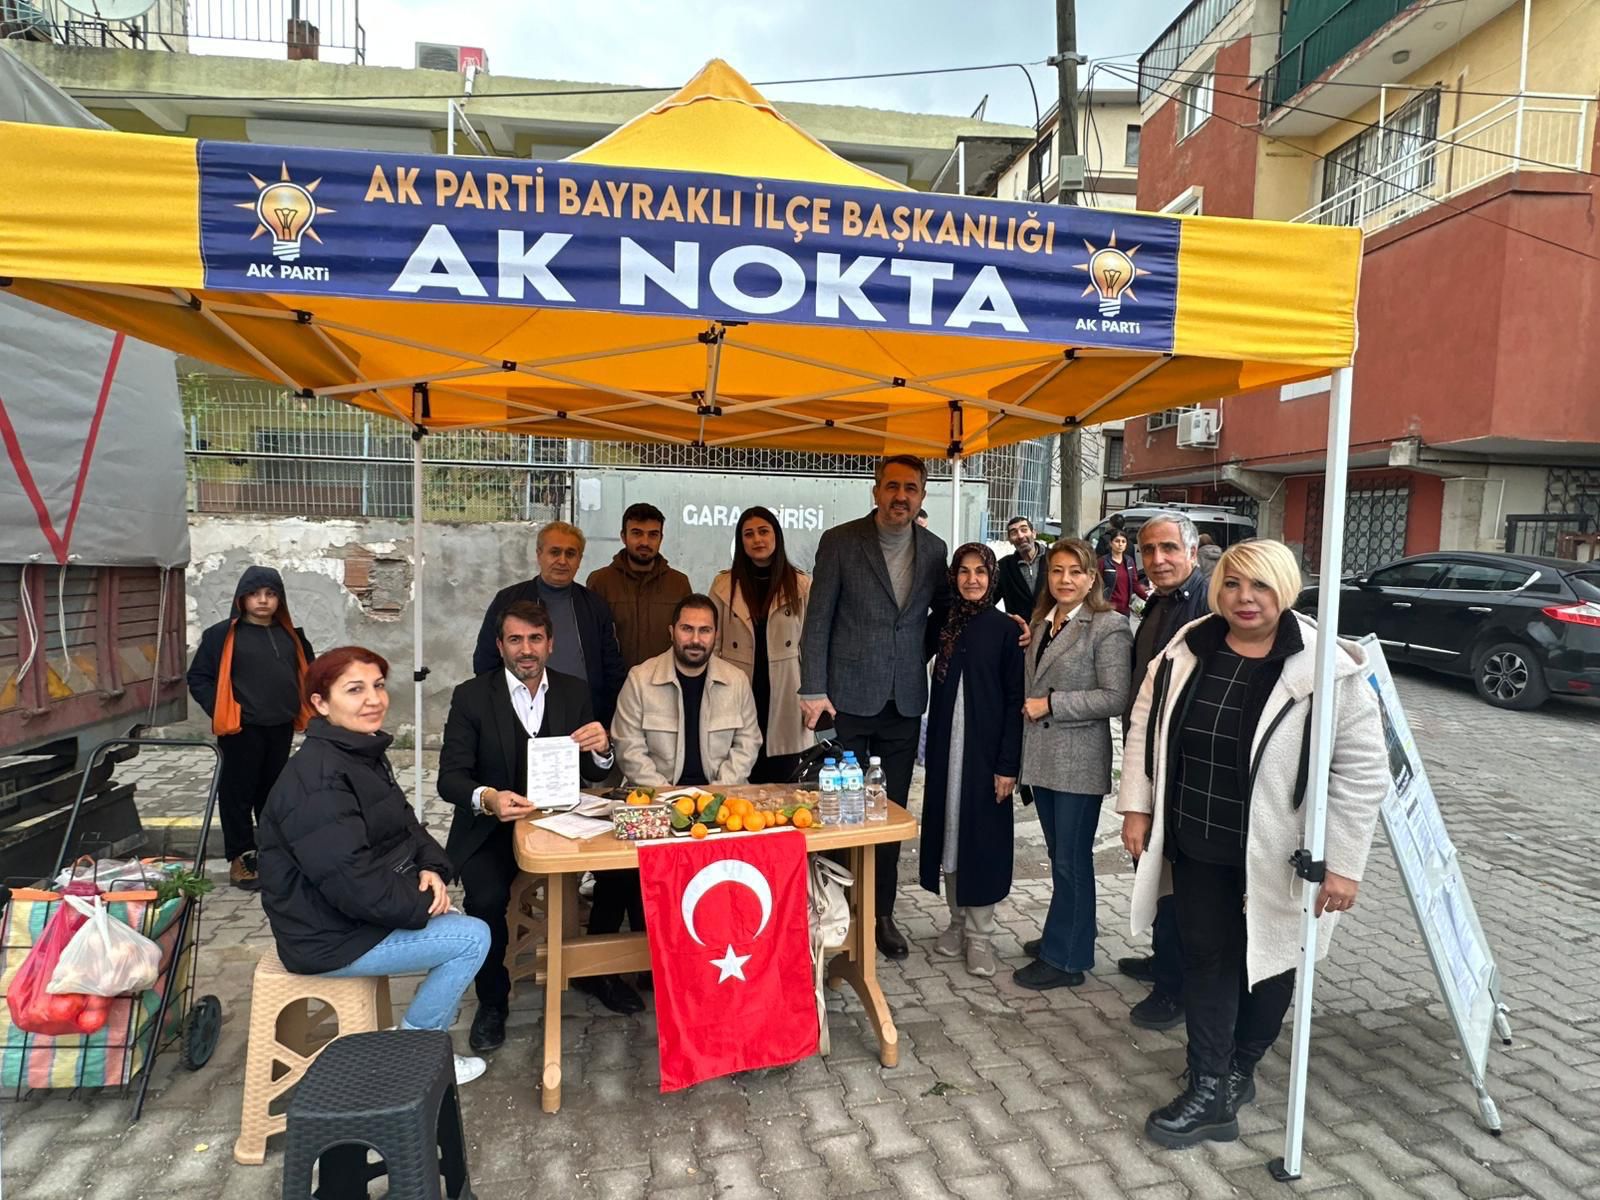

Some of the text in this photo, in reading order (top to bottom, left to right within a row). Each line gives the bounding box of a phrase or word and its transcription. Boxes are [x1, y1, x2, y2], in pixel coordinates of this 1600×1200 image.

[364, 164, 1055, 255] AK PARTİ BAYRAKLI İLÇE BAŞKANLIĞI
[246, 263, 274, 278] AK
[388, 223, 1030, 333] AK NOKTA
[1075, 318, 1097, 331] AK
[682, 504, 742, 526] GARA
